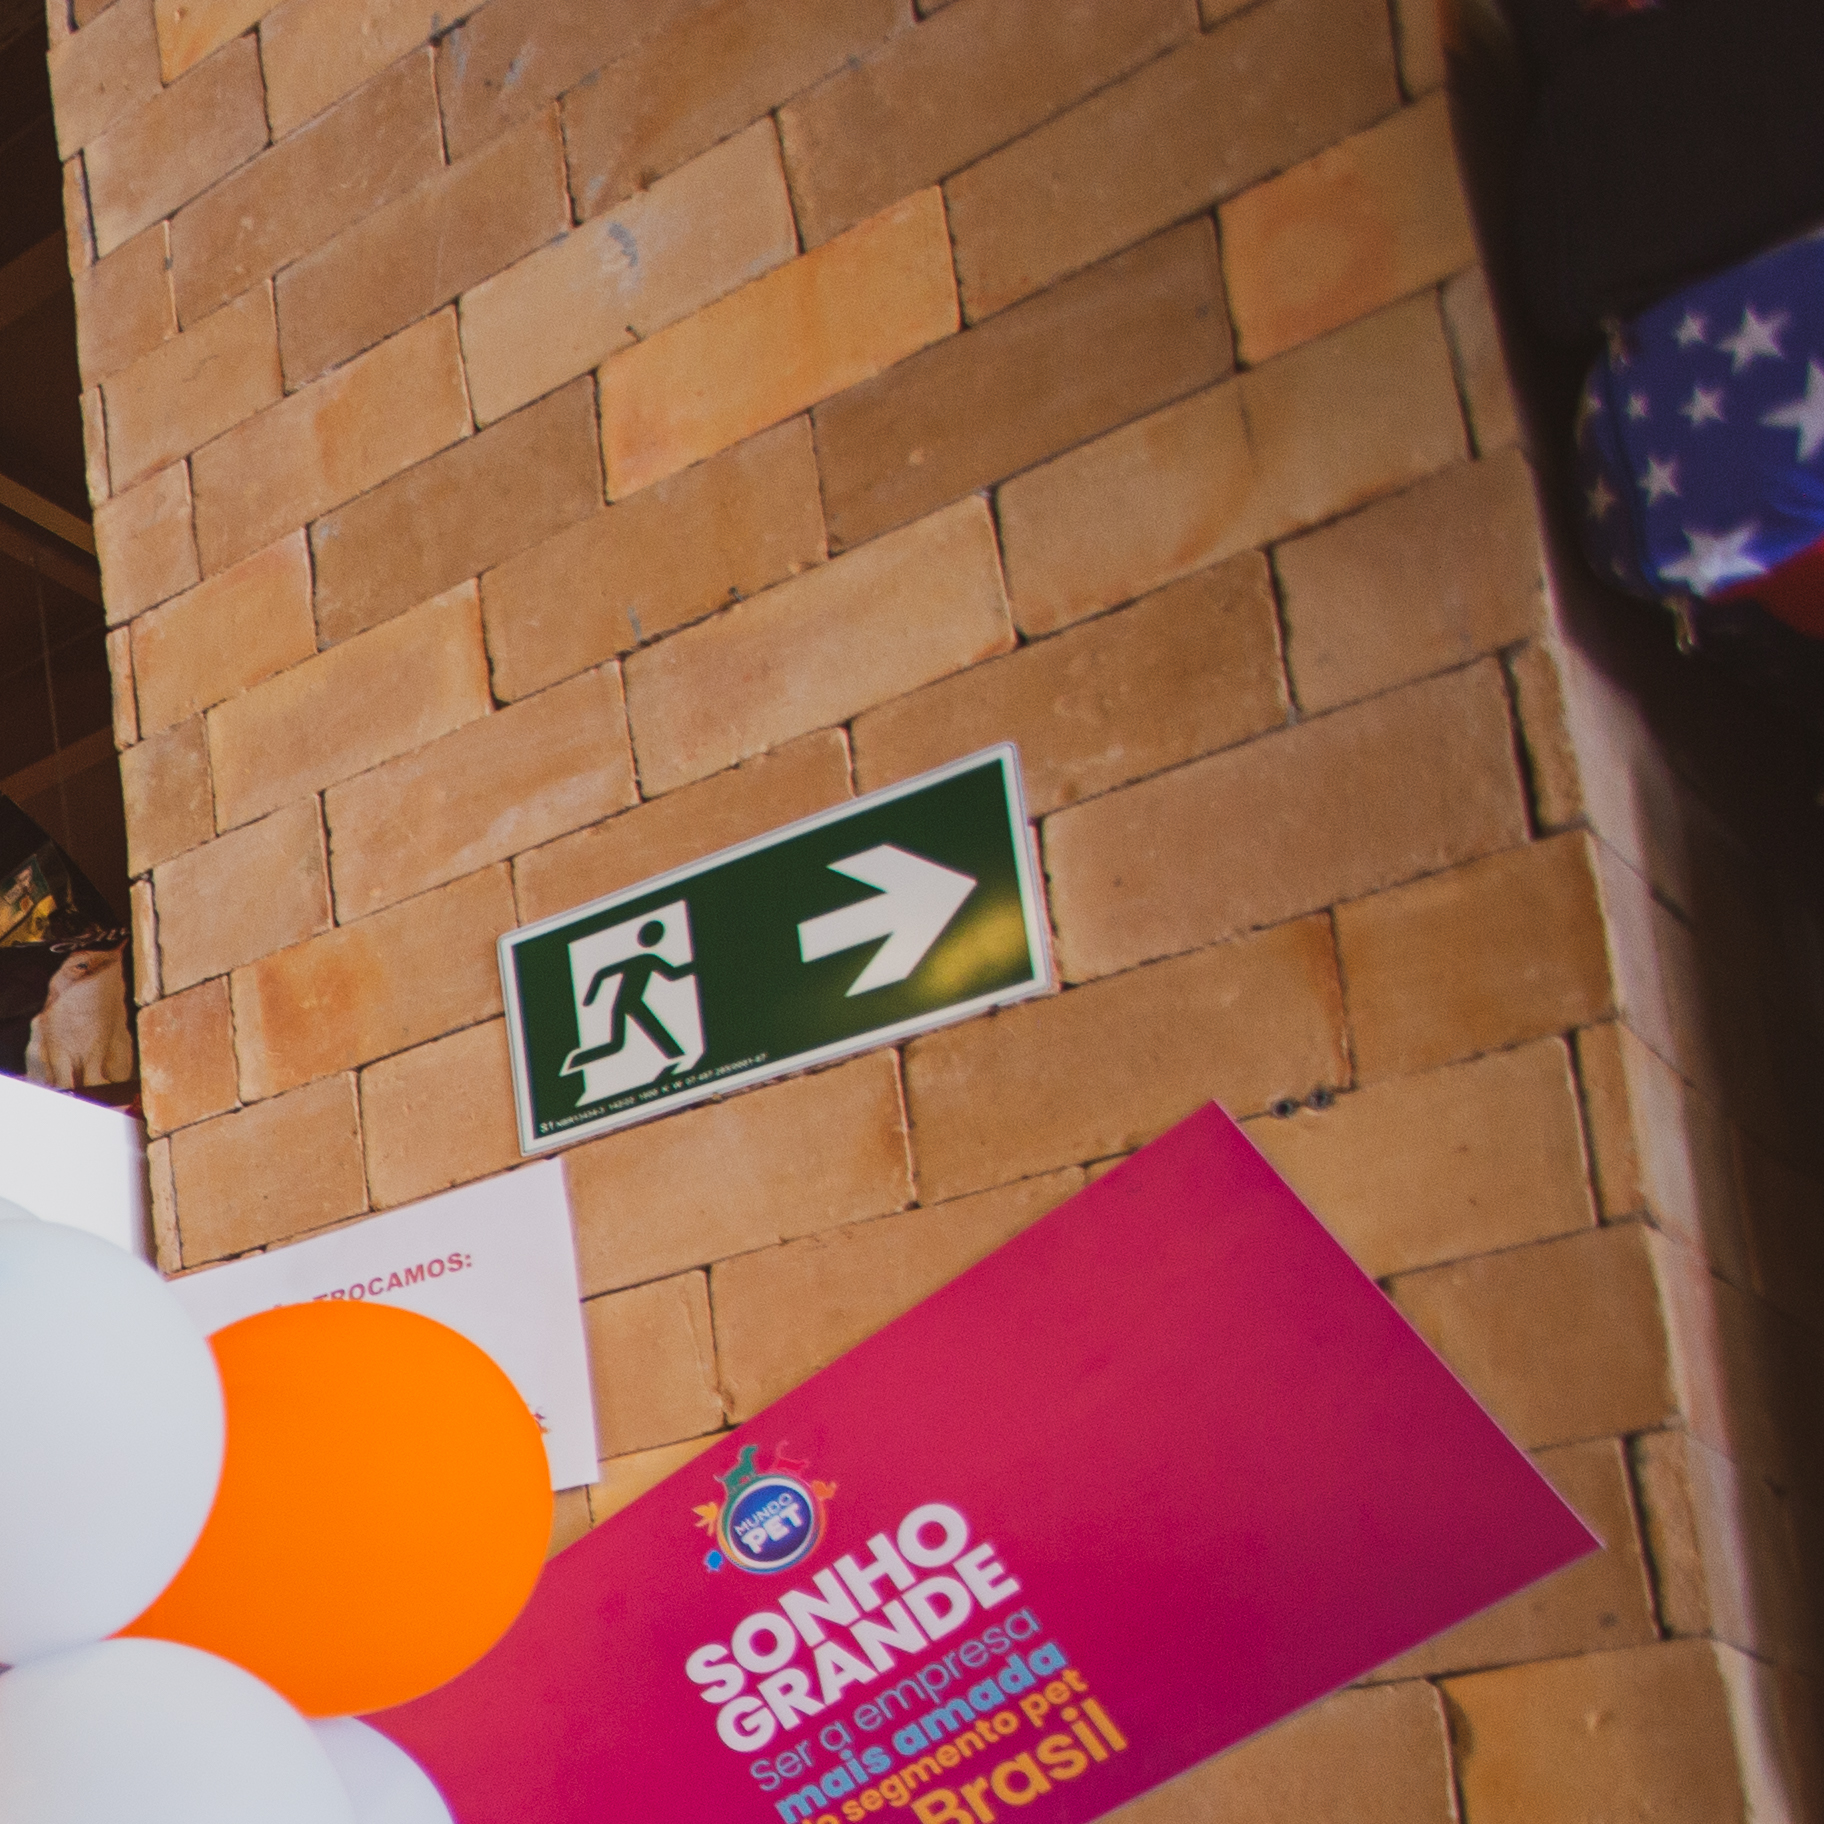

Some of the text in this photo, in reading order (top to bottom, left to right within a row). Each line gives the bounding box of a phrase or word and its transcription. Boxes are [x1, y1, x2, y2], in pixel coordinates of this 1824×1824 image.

[734, 1492, 793, 1538] MUNDO
[741, 1502, 803, 1555] PET
[683, 1503, 968, 1704] SONHO
[716, 1543, 1022, 1753] GRANDE
[749, 1606, 1043, 1792] Ser a empresa
[841, 1708, 1019, 1822] segmento
[1020, 1667, 1090, 1728] pet
[892, 1641, 1071, 1758] amada
